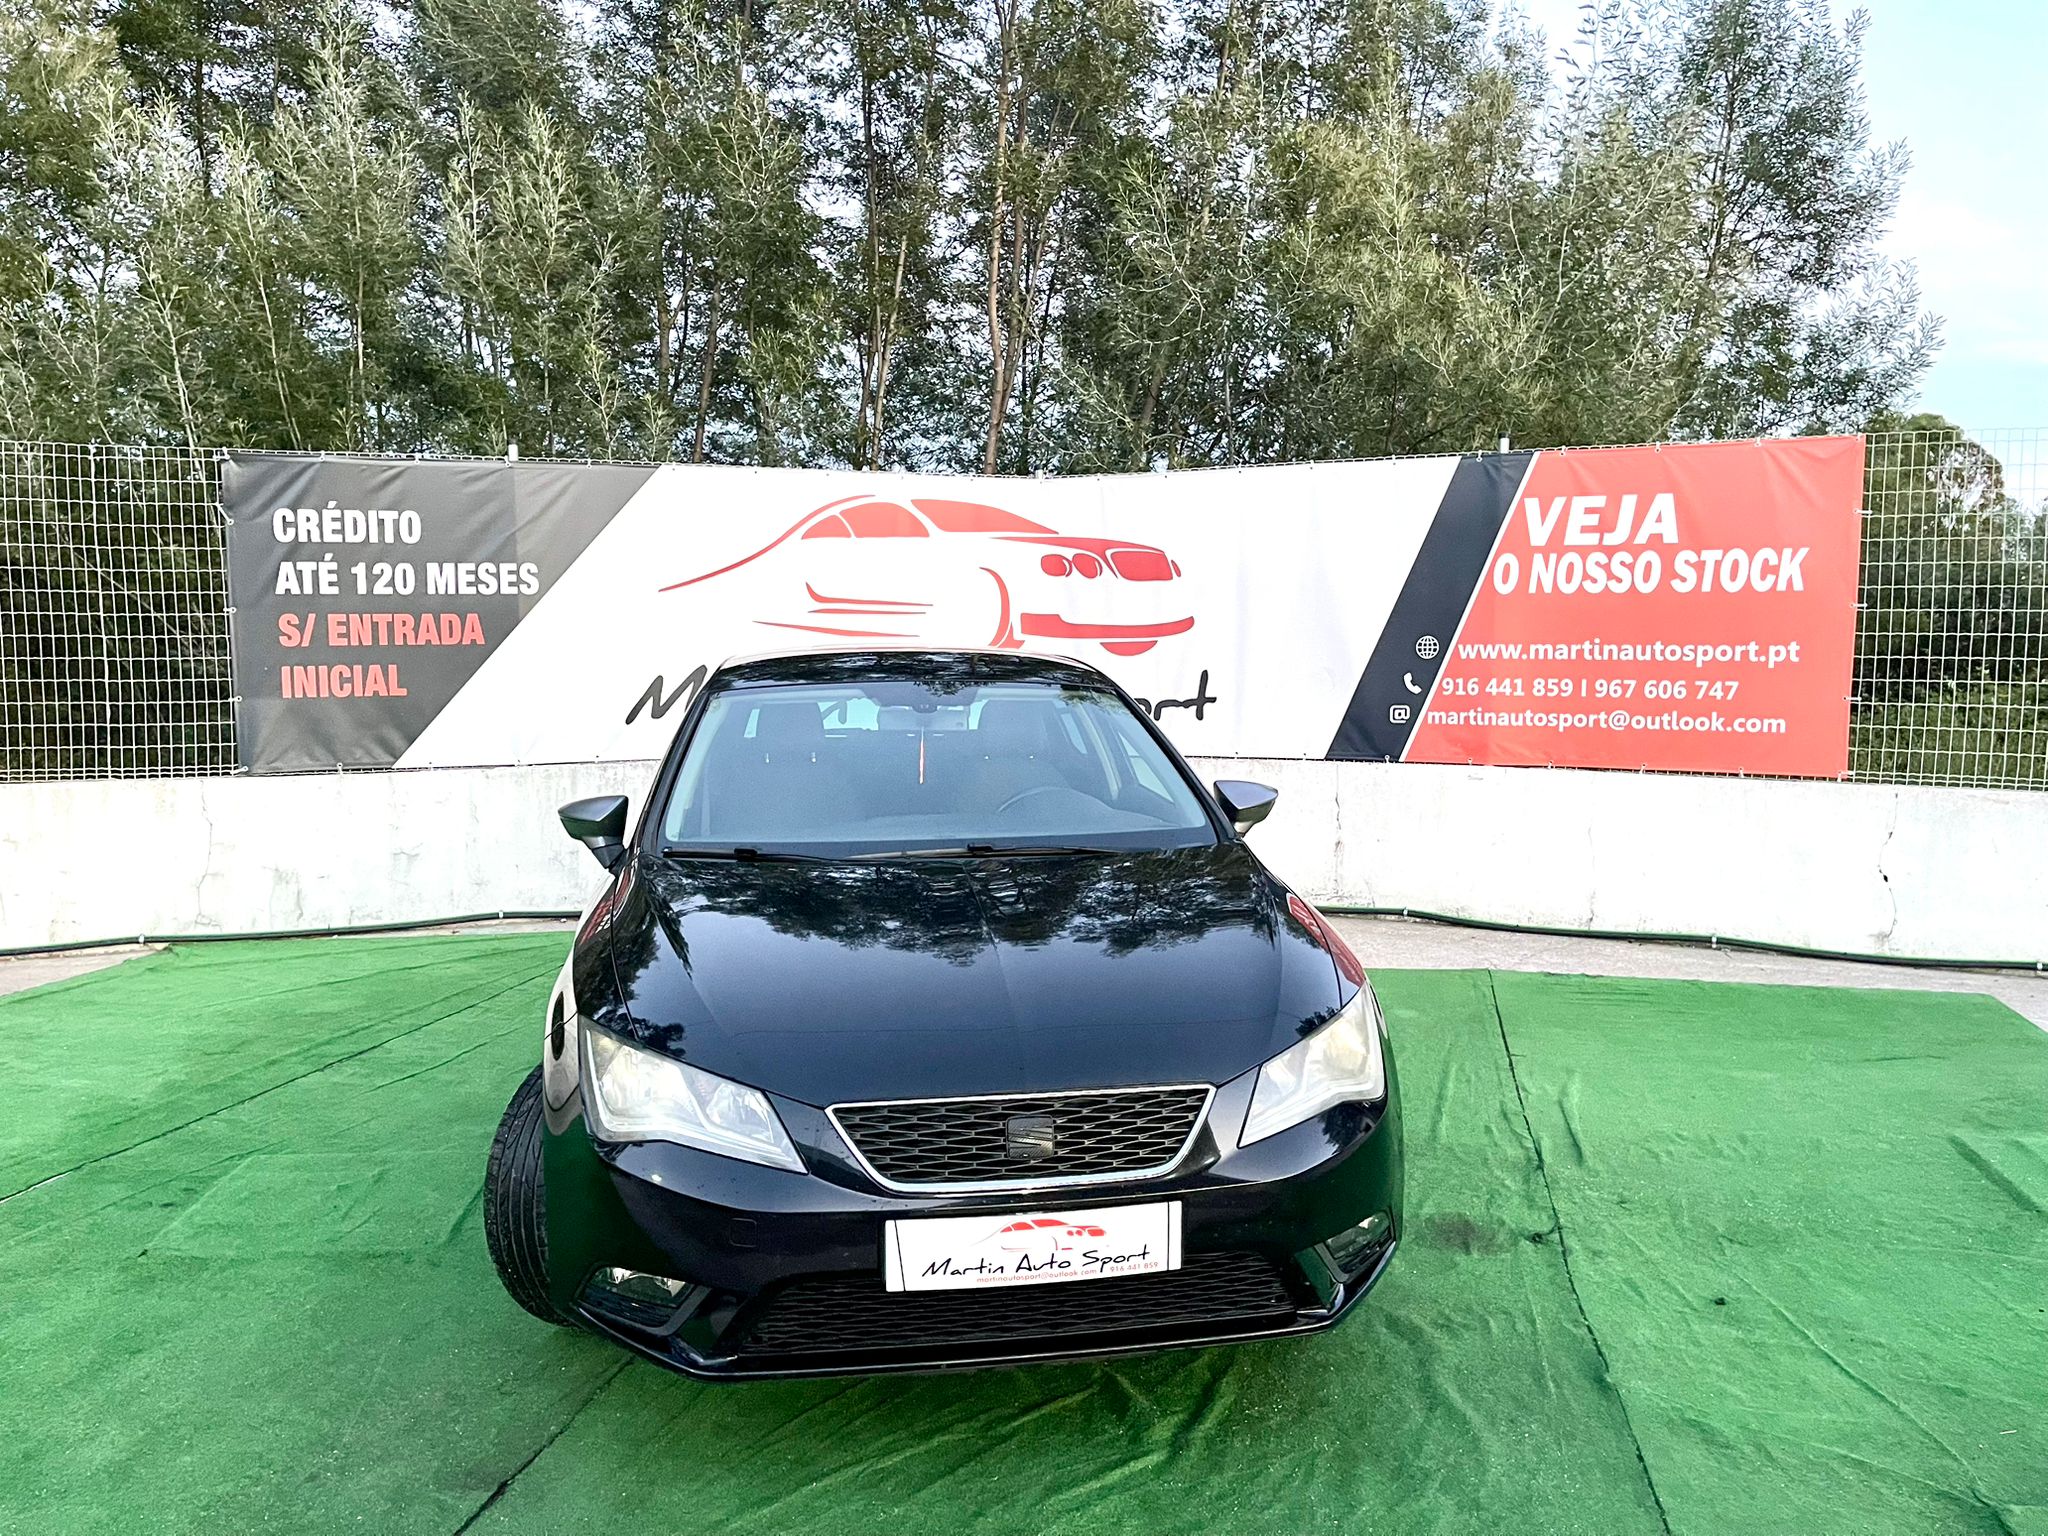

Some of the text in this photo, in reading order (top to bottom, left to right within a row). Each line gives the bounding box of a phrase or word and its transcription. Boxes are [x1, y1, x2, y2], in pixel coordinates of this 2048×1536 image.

[272, 500, 422, 545] CRÉDITO
[1524, 493, 1679, 547] VEJA
[275, 552, 540, 595] ATÉ 120 MESES
[1493, 547, 1809, 595] O NOSSO STOCK
[278, 613, 486, 647] S/ ENTRADA
[1458, 638, 1801, 668] www.martinautosport.pt
[281, 664, 408, 698] INICIAL
[1441, 677, 1480, 697] 916
[1485, 677, 1525, 697] 441
[1532, 678, 1574, 698] 859
[1594, 680, 1636, 700] 967
[1643, 681, 1688, 700] 606
[1695, 681, 1739, 701] 747
[1427, 707, 1787, 734] martinautosport@outlook.com
[922, 1243, 1150, 1277] Martin Auto Sport
